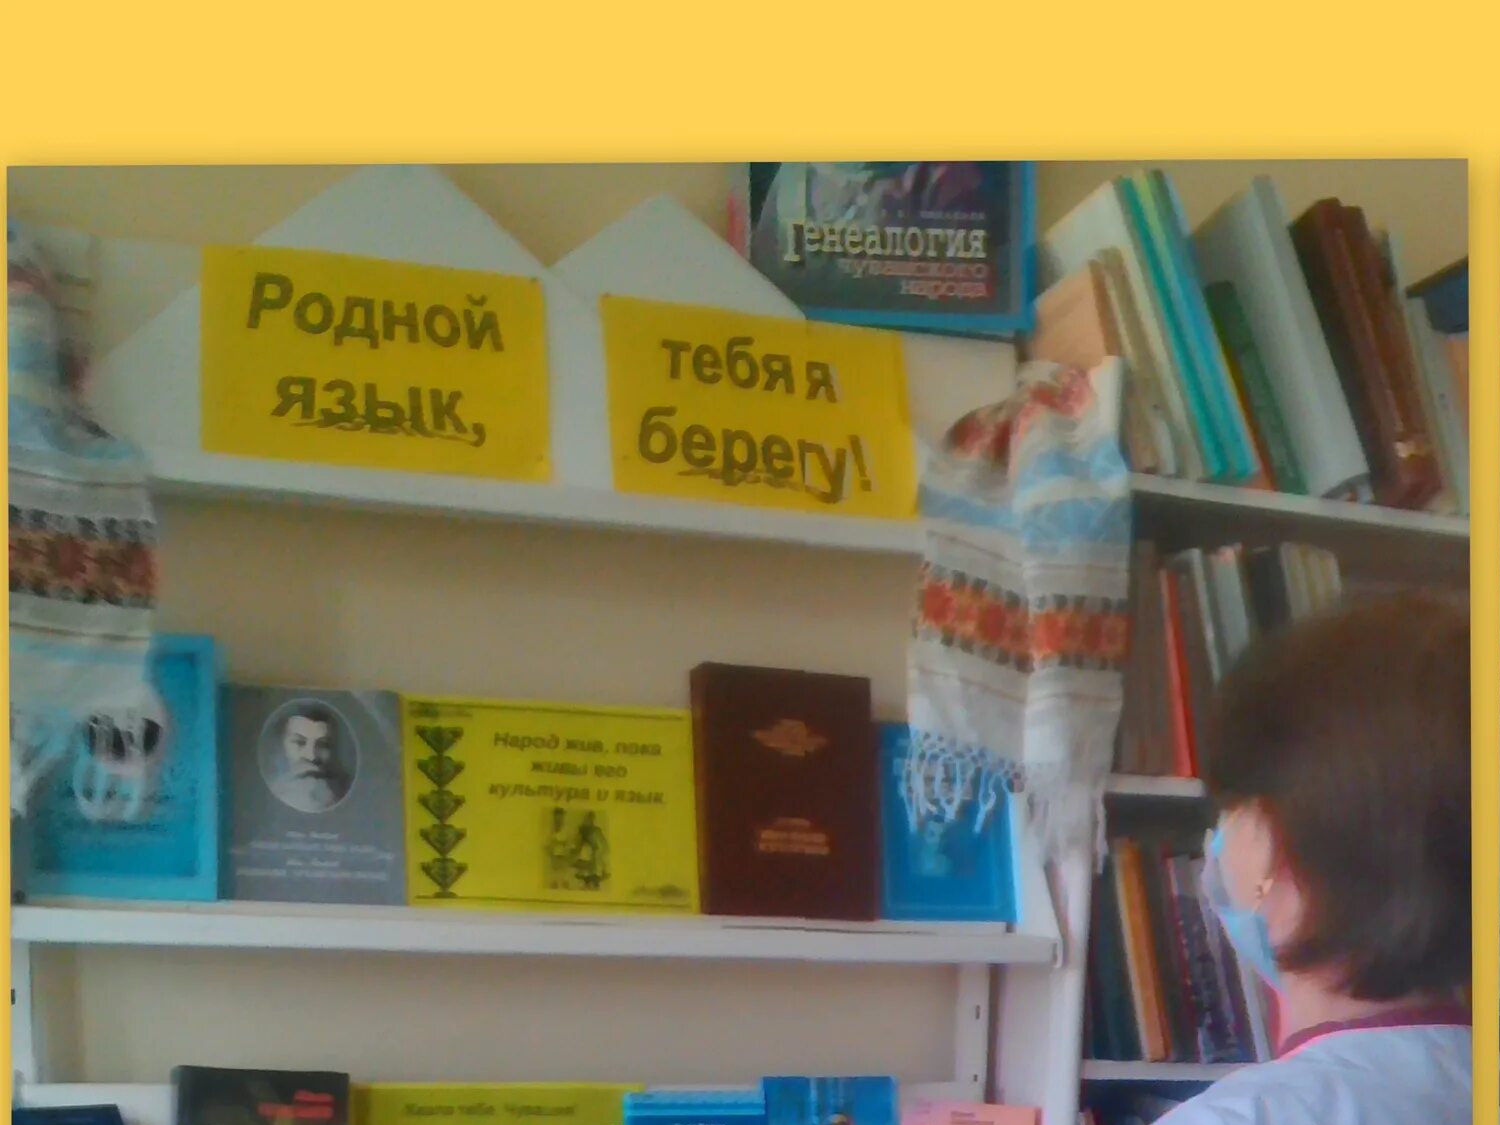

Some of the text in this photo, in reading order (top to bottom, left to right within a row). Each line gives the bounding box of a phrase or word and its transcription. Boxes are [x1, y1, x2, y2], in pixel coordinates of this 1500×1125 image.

[784, 220, 988, 262] Генеалогия
[246, 273, 504, 352] Родной
[661, 335, 838, 404] тебя я
[271, 375, 487, 448] язык,
[638, 405, 873, 504] берегу!
